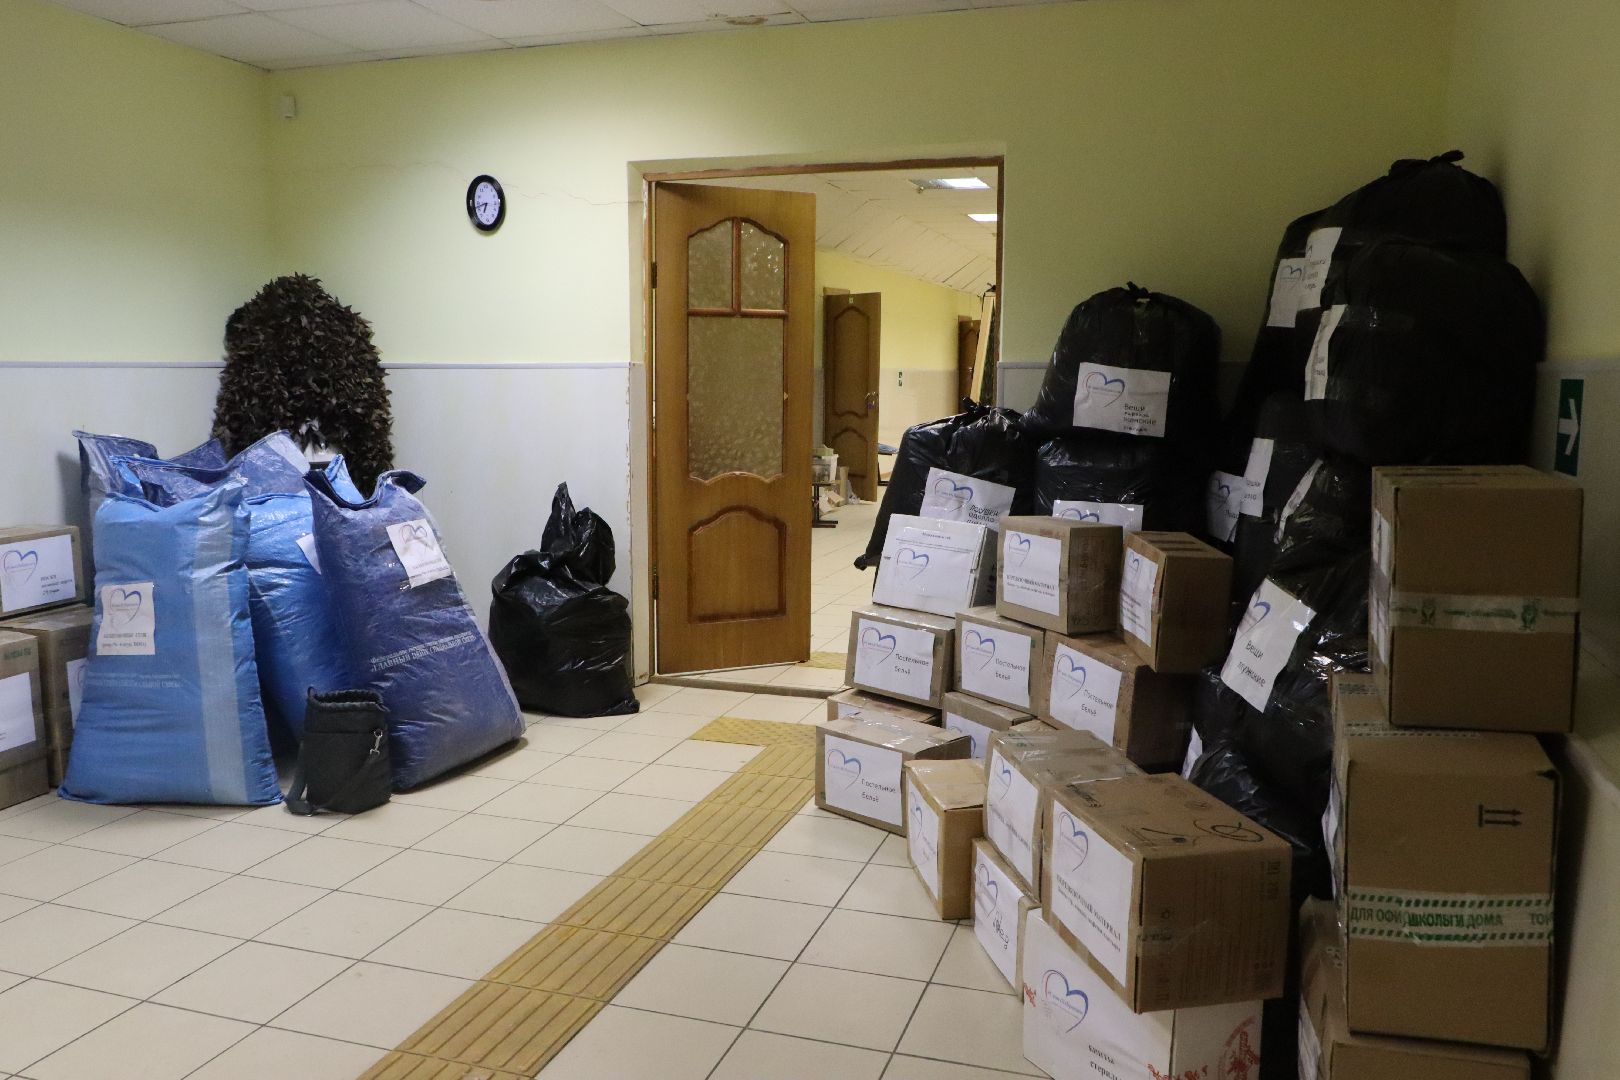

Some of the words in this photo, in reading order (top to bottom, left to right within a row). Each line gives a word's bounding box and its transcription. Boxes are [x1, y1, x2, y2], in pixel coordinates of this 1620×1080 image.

[1245, 640, 1264, 660] Вещи
[895, 653, 929, 667] Постельное
[861, 778, 896, 793] Постельное
[1351, 906, 1373, 921] ДЛЯ
[1466, 913, 1503, 928] ДОМА
